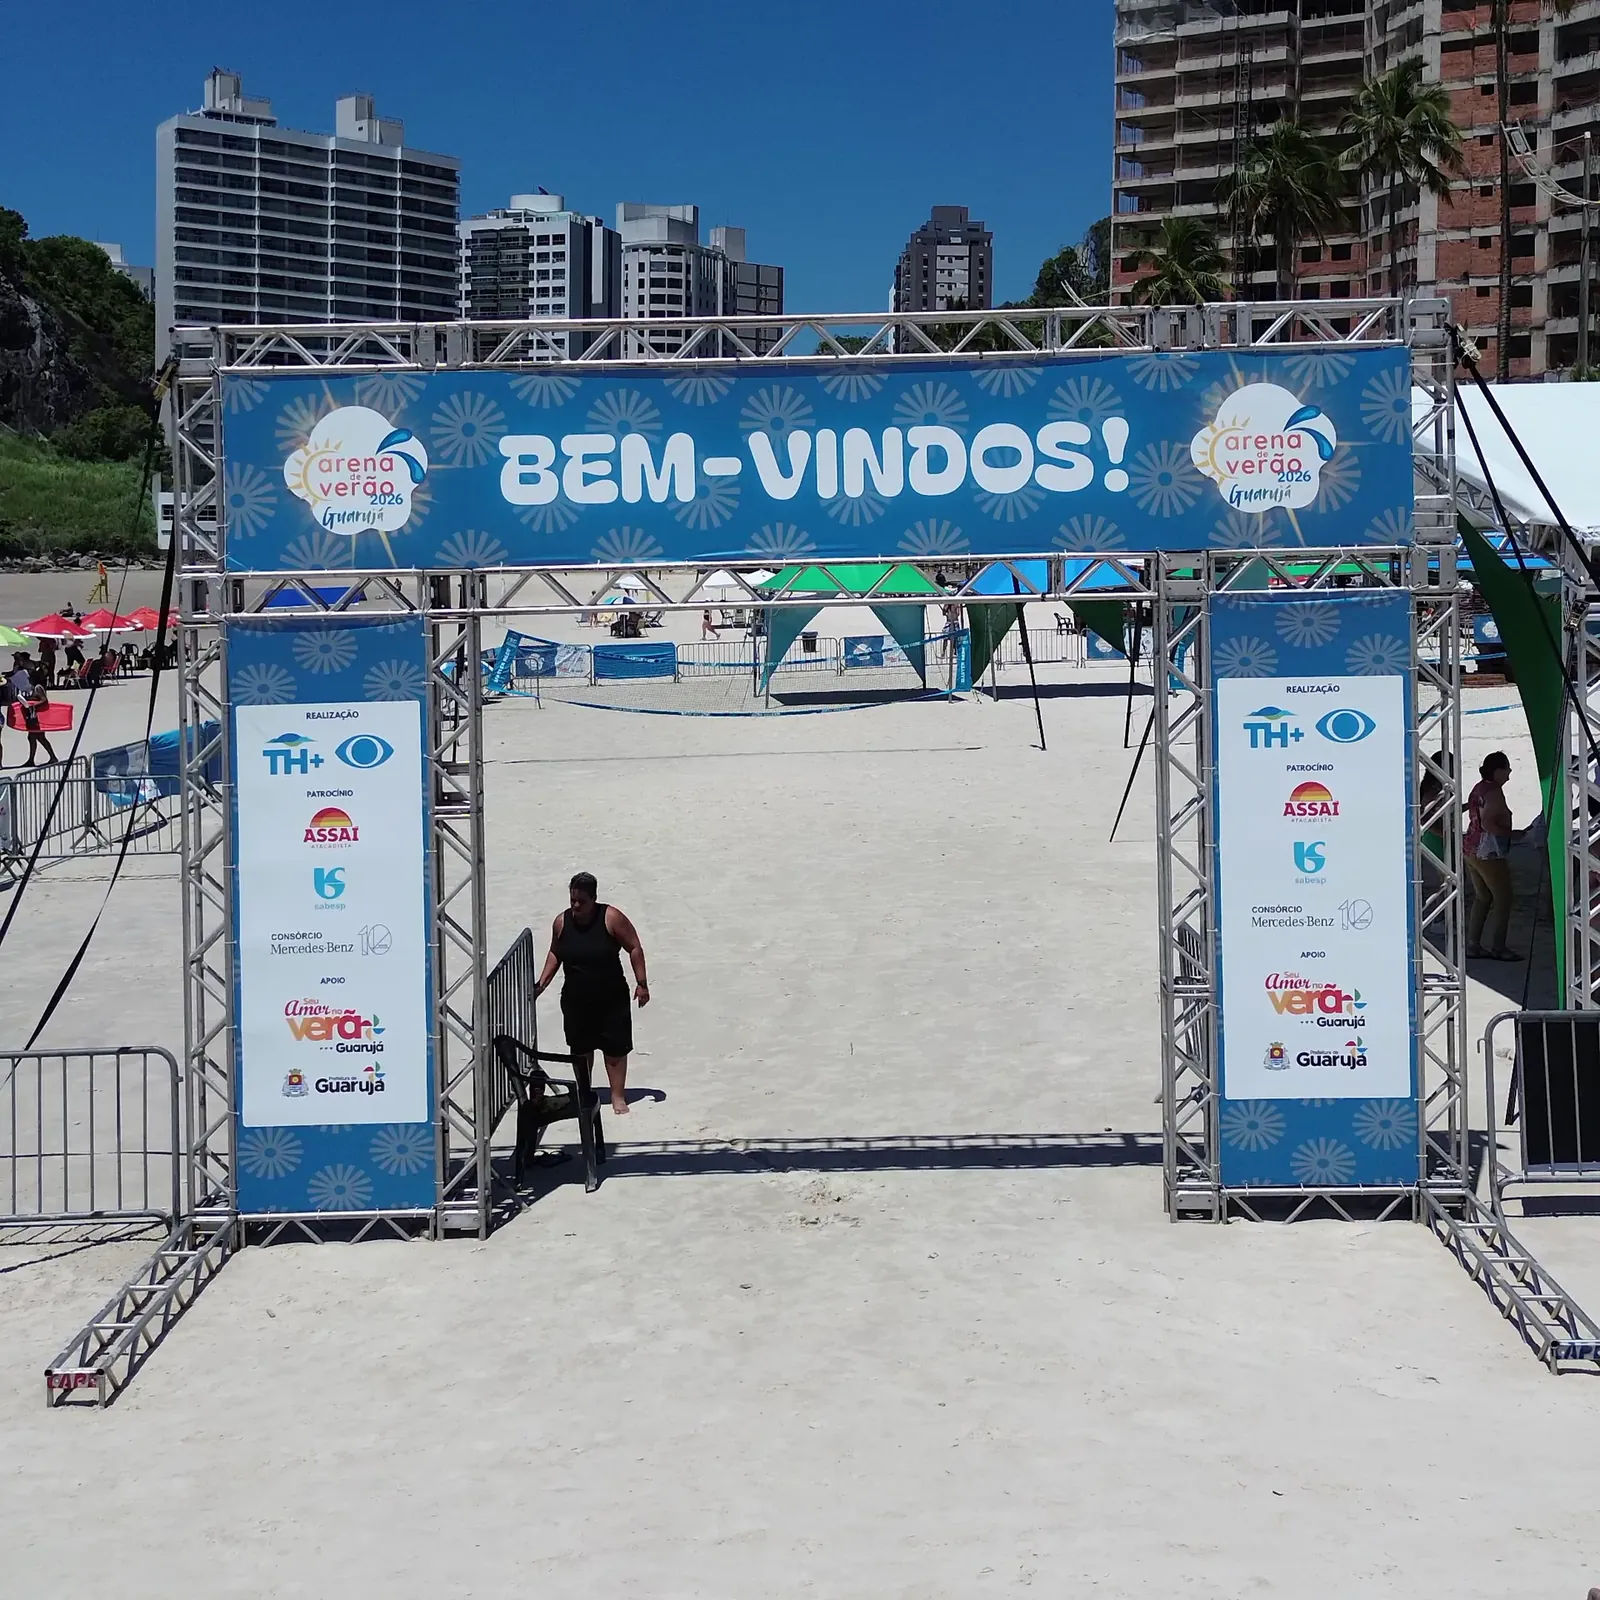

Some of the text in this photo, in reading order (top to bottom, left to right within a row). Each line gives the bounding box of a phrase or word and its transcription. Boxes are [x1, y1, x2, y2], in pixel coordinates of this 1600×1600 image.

[1225, 433, 1302, 451] arena
[499, 416, 1130, 505] BEM-VINDOS!
[1256, 450, 1268, 458] de
[318, 456, 394, 473] arena
[1226, 452, 1302, 474] verão
[350, 473, 361, 481] de
[1278, 470, 1311, 482] 2026
[319, 475, 394, 497] verão
[370, 494, 404, 505] 2026
[1229, 484, 1291, 508] Guarujá
[322, 506, 384, 530] Guarujá
[1286, 683, 1340, 694] REALIZAÇÃO
[306, 709, 359, 720] REALIZAÇÃO
[1243, 722, 1304, 748] TH+
[263, 748, 324, 775] TH+
[1286, 762, 1334, 772] PATROCÍNIO
[306, 789, 354, 798] PATROCÍNIO
[1294, 875, 1326, 884] sabesp
[314, 902, 346, 911] sabesp
[1251, 904, 1303, 914] CONSÓRCIO
[1251, 915, 1334, 928] Mercedes-Benz
[271, 931, 323, 941] CONSÓRCIO
[270, 942, 354, 955] Mercedes-Benz
[1300, 951, 1326, 959] APOIO
[320, 977, 346, 985] APOIO
[1265, 972, 1310, 989] Amor
[284, 1000, 330, 1016] Amor
[1296, 1051, 1367, 1070] Guarujá
[315, 1078, 385, 1096] Guarujá
